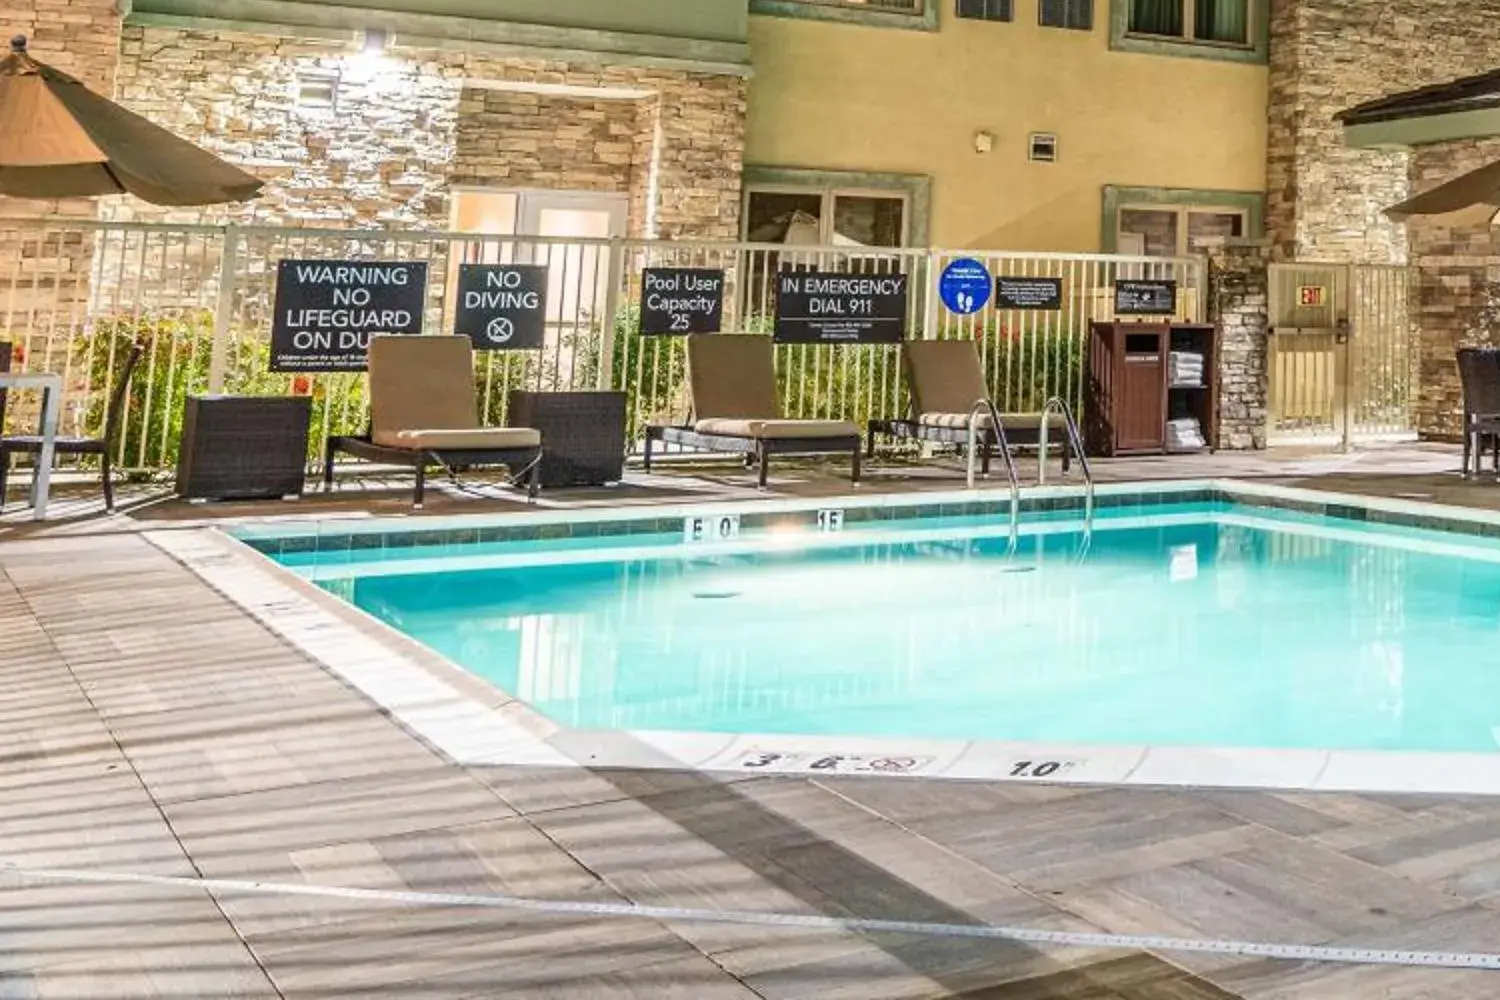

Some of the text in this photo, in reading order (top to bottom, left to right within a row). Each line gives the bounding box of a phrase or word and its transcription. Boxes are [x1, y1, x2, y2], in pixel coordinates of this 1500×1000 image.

[297, 266, 409, 285] WARNING
[487, 271, 521, 288] NO
[645, 274, 720, 292] Pool User
[781, 278, 901, 295] IN EMERGENCY
[332, 288, 370, 306] NO
[465, 291, 539, 309] DIVING
[647, 294, 716, 314] Capacity
[809, 298, 871, 313] DIAL 911
[286, 309, 411, 328] LIFEGUARD
[670, 314, 690, 330] 25
[293, 331, 332, 349] ON
